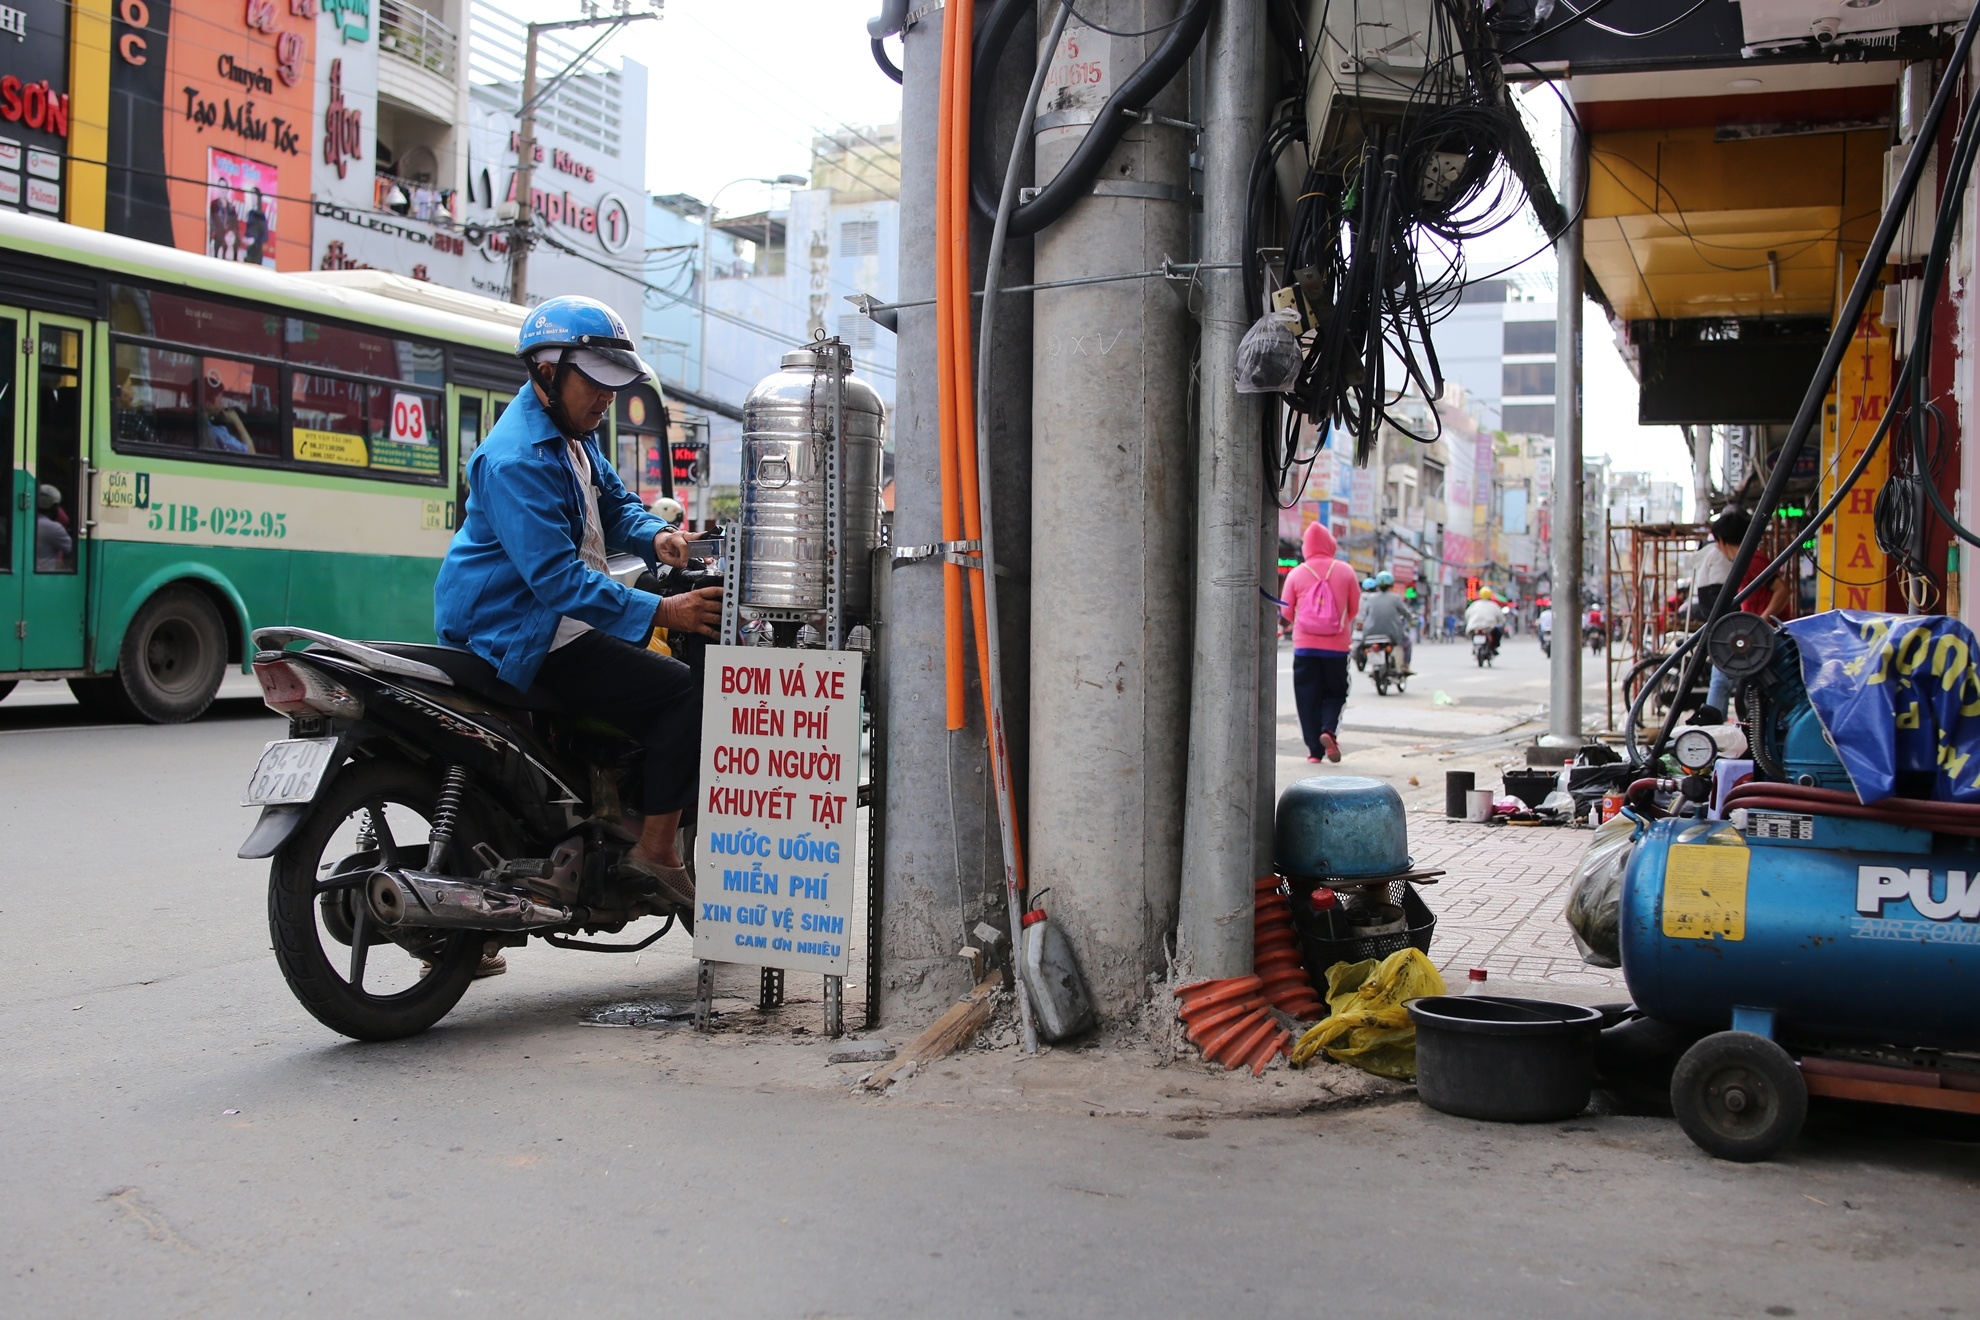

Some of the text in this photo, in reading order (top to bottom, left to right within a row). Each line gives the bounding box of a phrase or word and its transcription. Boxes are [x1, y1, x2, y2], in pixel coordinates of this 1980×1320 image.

[218, 54, 273, 95] Chuyên
[0, 74, 68, 137] SƠN
[183, 86, 299, 156] Tạo Mẫu Tóc
[554, 148, 595, 183] Khoa
[315, 201, 433, 246] COLLECTION
[394, 401, 422, 439] 03
[102, 487, 134, 505] XUỐNG
[149, 503, 287, 539] 51B-022.95
[721, 662, 845, 699] BƠM VÁ XE
[732, 700, 830, 739] MIỄN PHÍ
[713, 745, 841, 781] CHO NGƯỜI
[708, 786, 847, 829] KHUYẾT TẬT
[710, 828, 840, 864] NƯỚC UỐNG
[723, 862, 830, 900] MIỄN PHÍ
[702, 903, 844, 935] XIN GIỮ VỆ SINH
[1857, 920, 1904, 939] AIR
[735, 934, 767, 948] CAM
[772, 937, 792, 952] ƠN
